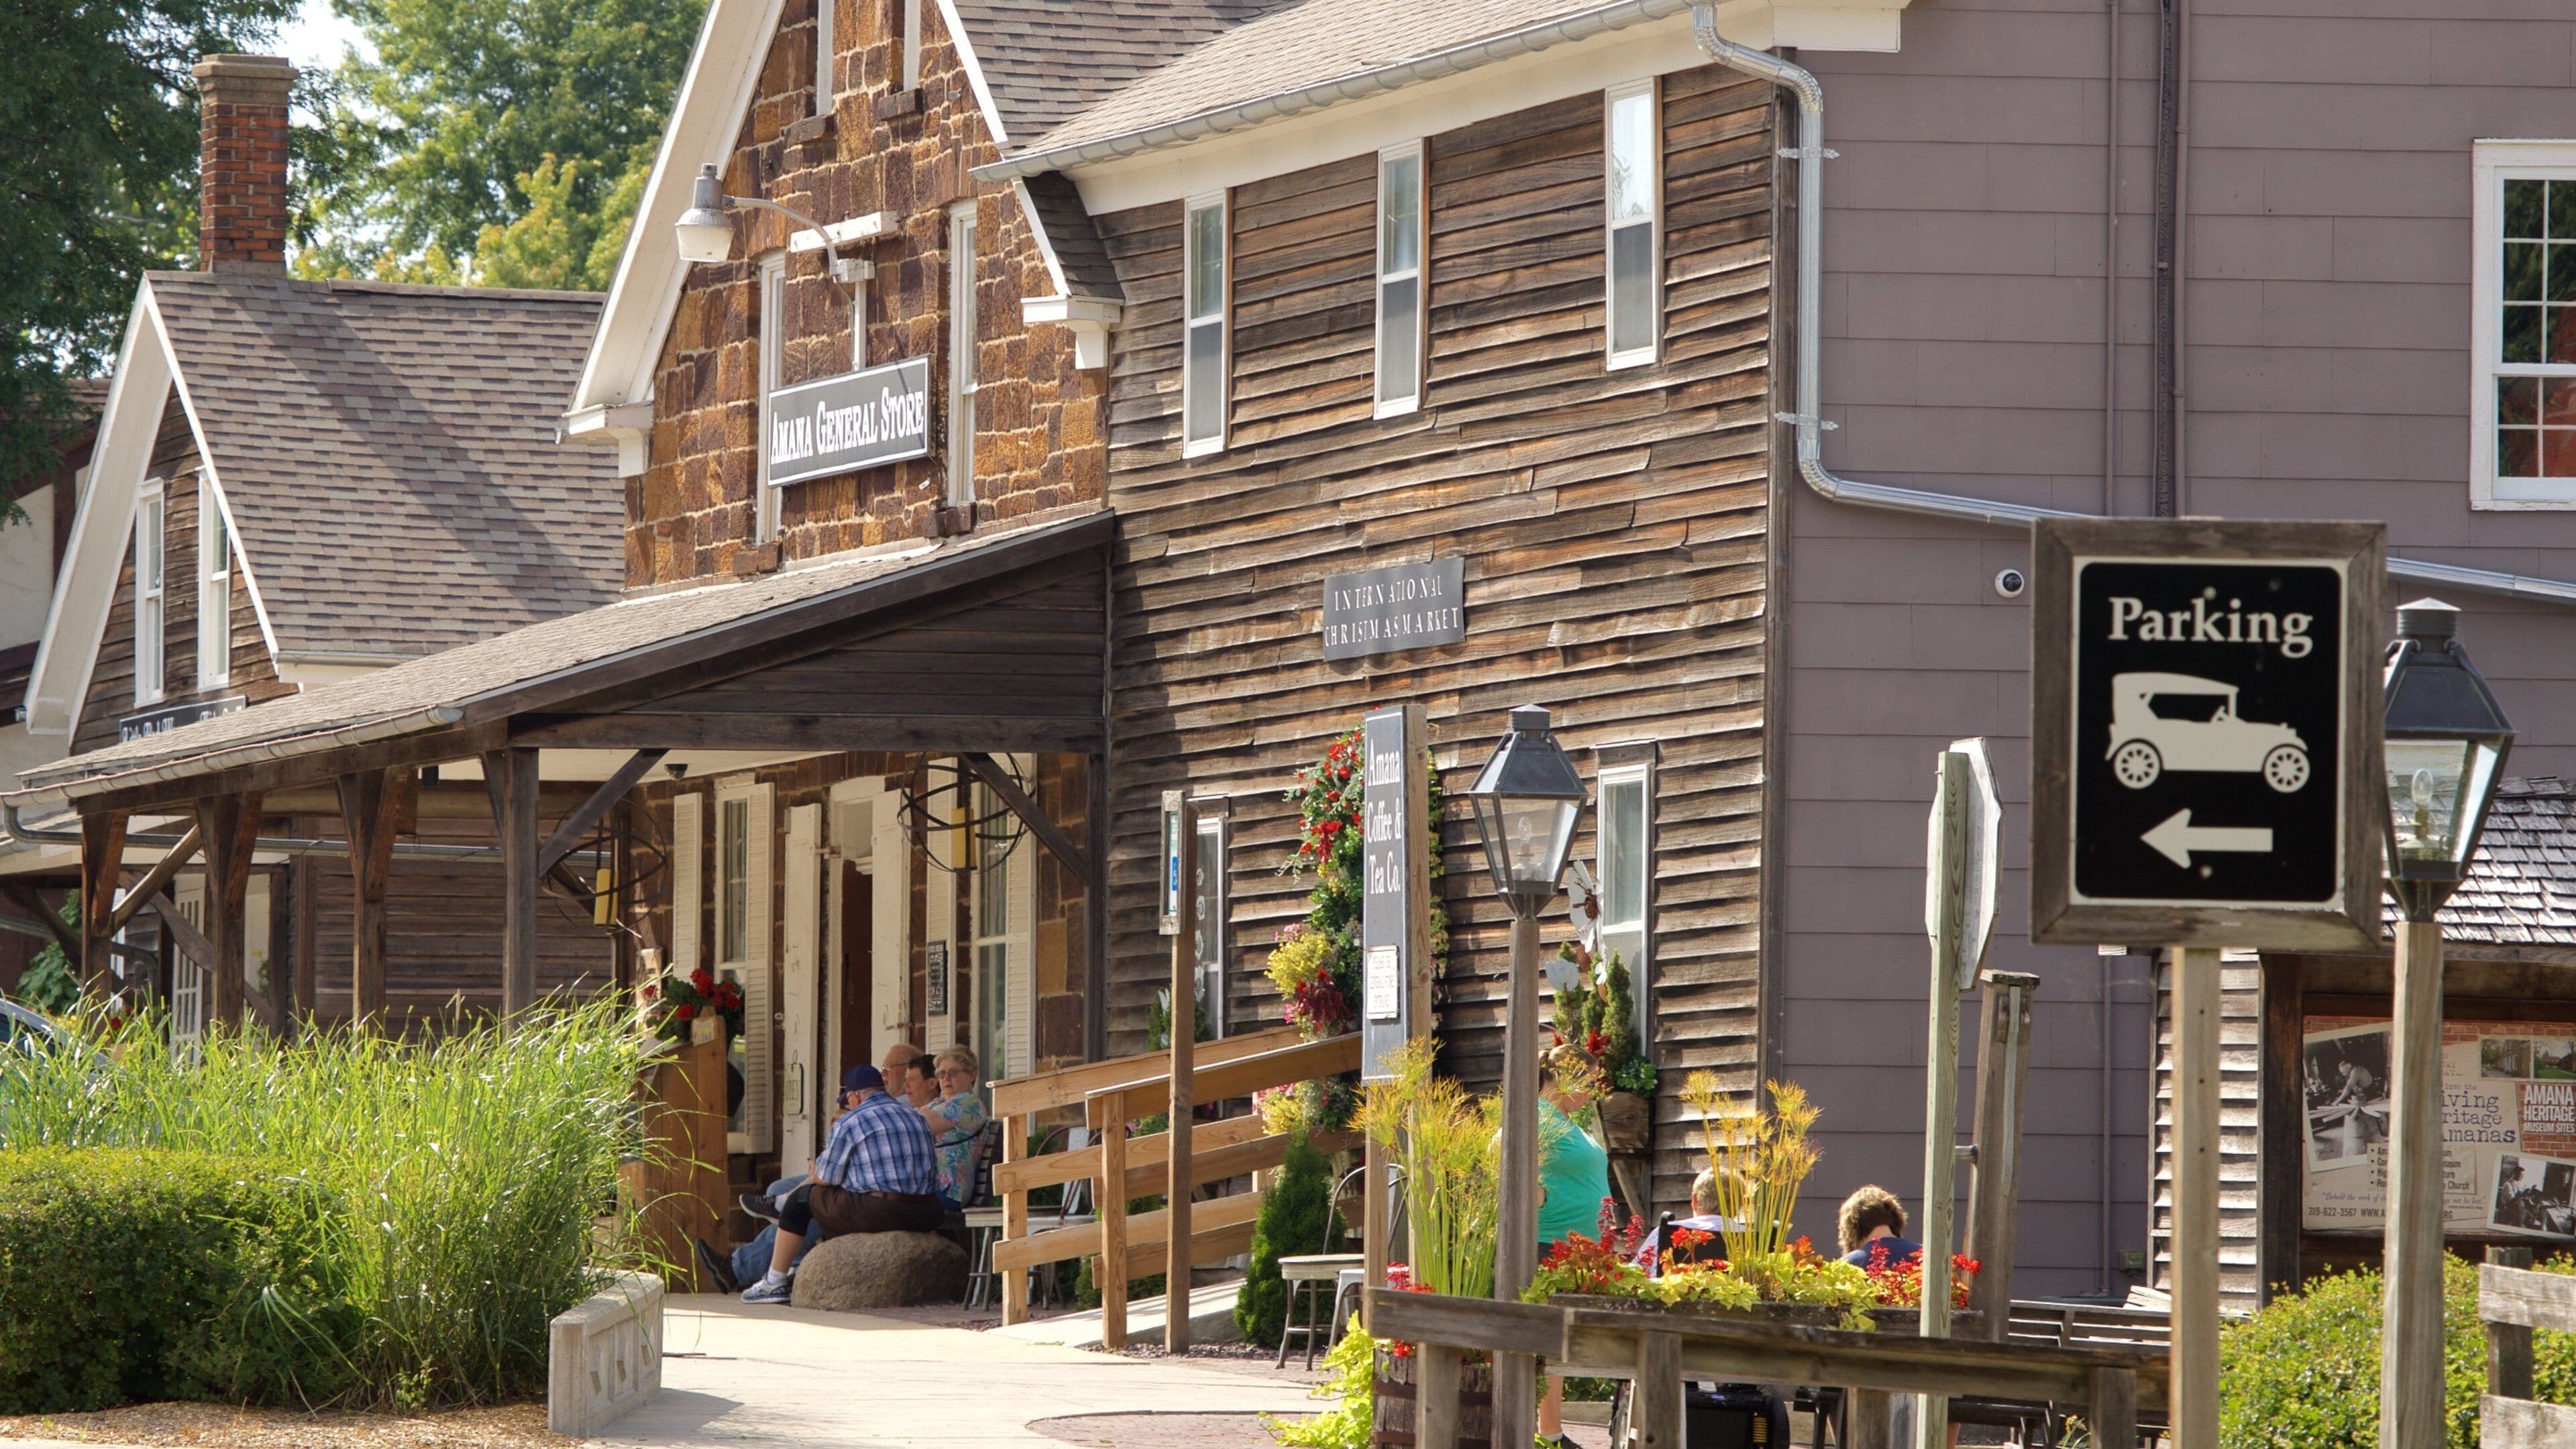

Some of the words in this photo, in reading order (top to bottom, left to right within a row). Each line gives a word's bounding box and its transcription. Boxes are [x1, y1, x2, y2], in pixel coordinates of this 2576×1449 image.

[771, 412, 813, 465] AMANA
[816, 400, 877, 455] GENERAL
[881, 386, 924, 441] STORE
[1335, 576, 1442, 611] INTERNATIONAL
[2107, 596, 2314, 659] Parking
[1368, 739, 1401, 786] Amana
[1367, 800, 1392, 843] Coffee
[1395, 798, 1401, 839] &
[1368, 854, 1385, 894] Tea
[1387, 851, 1401, 893] Co.
[2442, 1090, 2499, 1113] iving
[2524, 1084, 2575, 1106] AMANA
[2442, 1109, 2502, 1128] ritage
[2524, 1105, 2575, 1122] HERITAGE
[2442, 1128, 2516, 1143] manas
[2524, 1122, 2555, 1132] MUSEUM
[2556, 1122, 2575, 1133] SITES
[2448, 1181, 2470, 1190] Church
[2308, 1207, 2357, 1217] 319-622-3567
